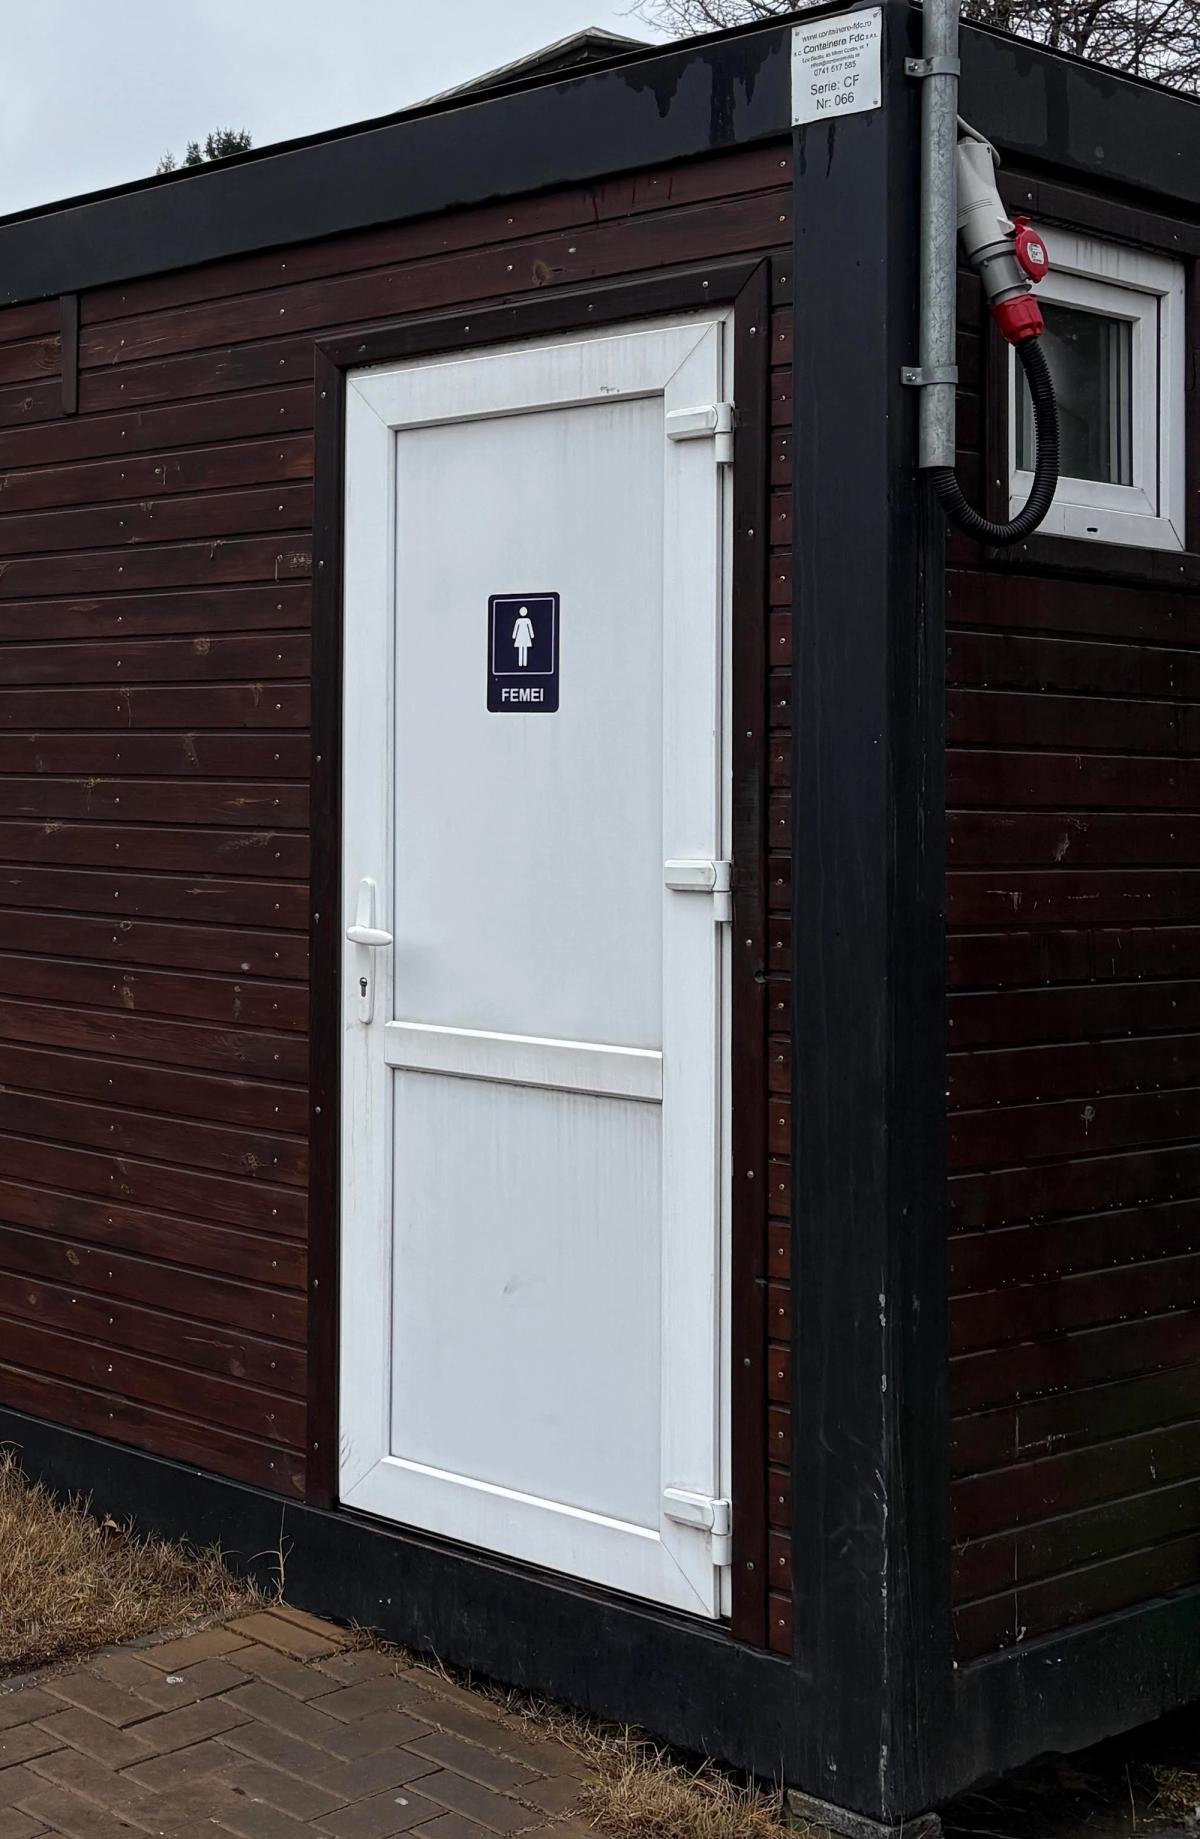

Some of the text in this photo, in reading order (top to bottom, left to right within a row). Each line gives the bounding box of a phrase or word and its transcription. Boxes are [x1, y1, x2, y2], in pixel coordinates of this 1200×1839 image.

[848, 33, 865, 44] Fdc
[810, 74, 860, 96] Serie: CF
[834, 91, 855, 106] 066
[501, 687, 544, 702] FEMEI
